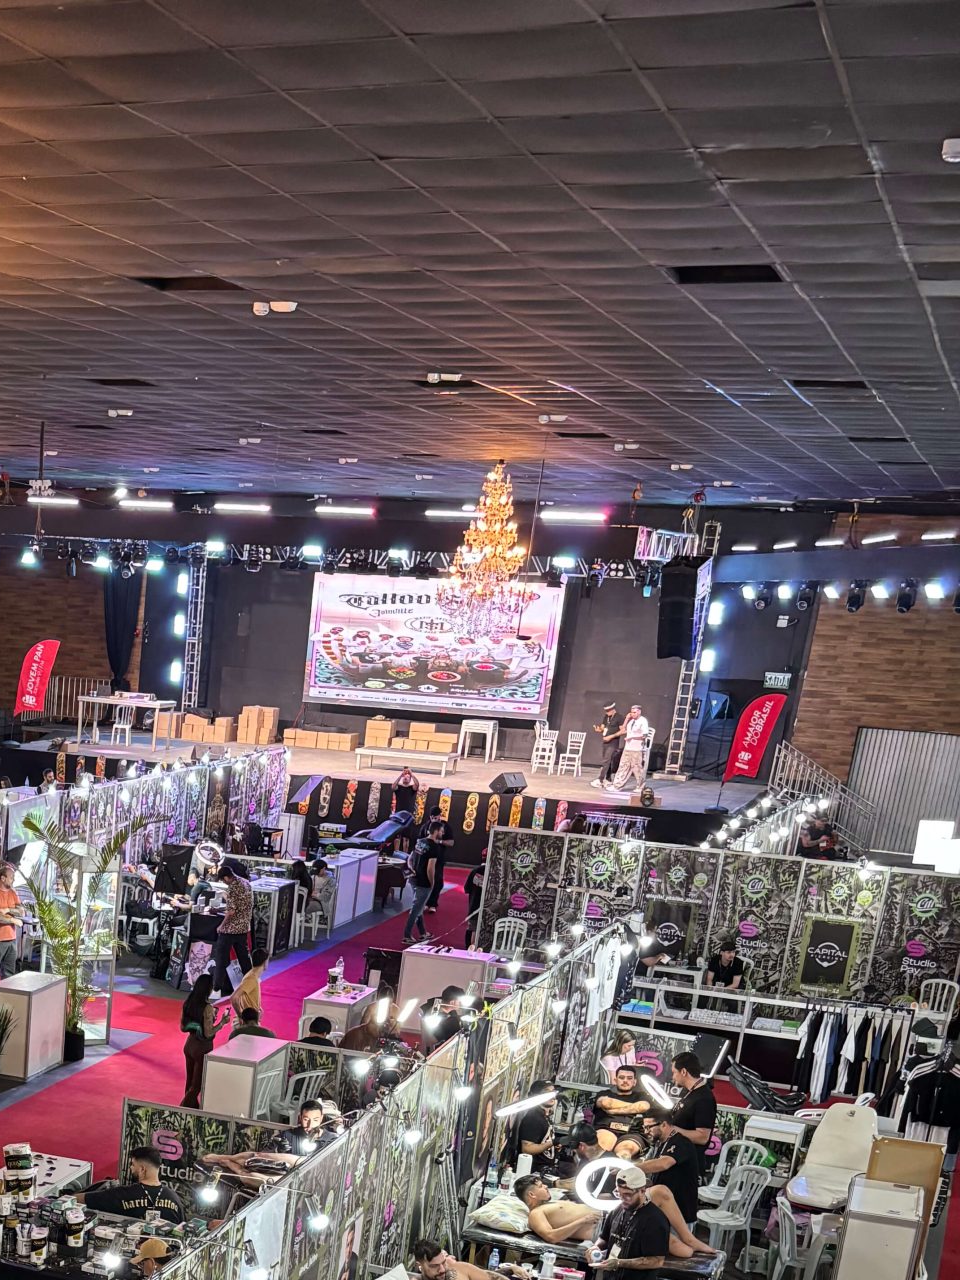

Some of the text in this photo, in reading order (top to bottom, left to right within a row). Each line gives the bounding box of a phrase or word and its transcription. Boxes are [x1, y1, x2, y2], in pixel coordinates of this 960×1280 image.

[27, 663, 38, 694] JOVEM
[34, 644, 45, 662] PAN
[507, 908, 537, 919] Studio
[655, 928, 687, 937] APITAL
[735, 937, 768, 949] Studio
[807, 947, 848, 958] CAPITAL
[901, 956, 937, 968] Studio
[900, 964, 922, 976] Pay
